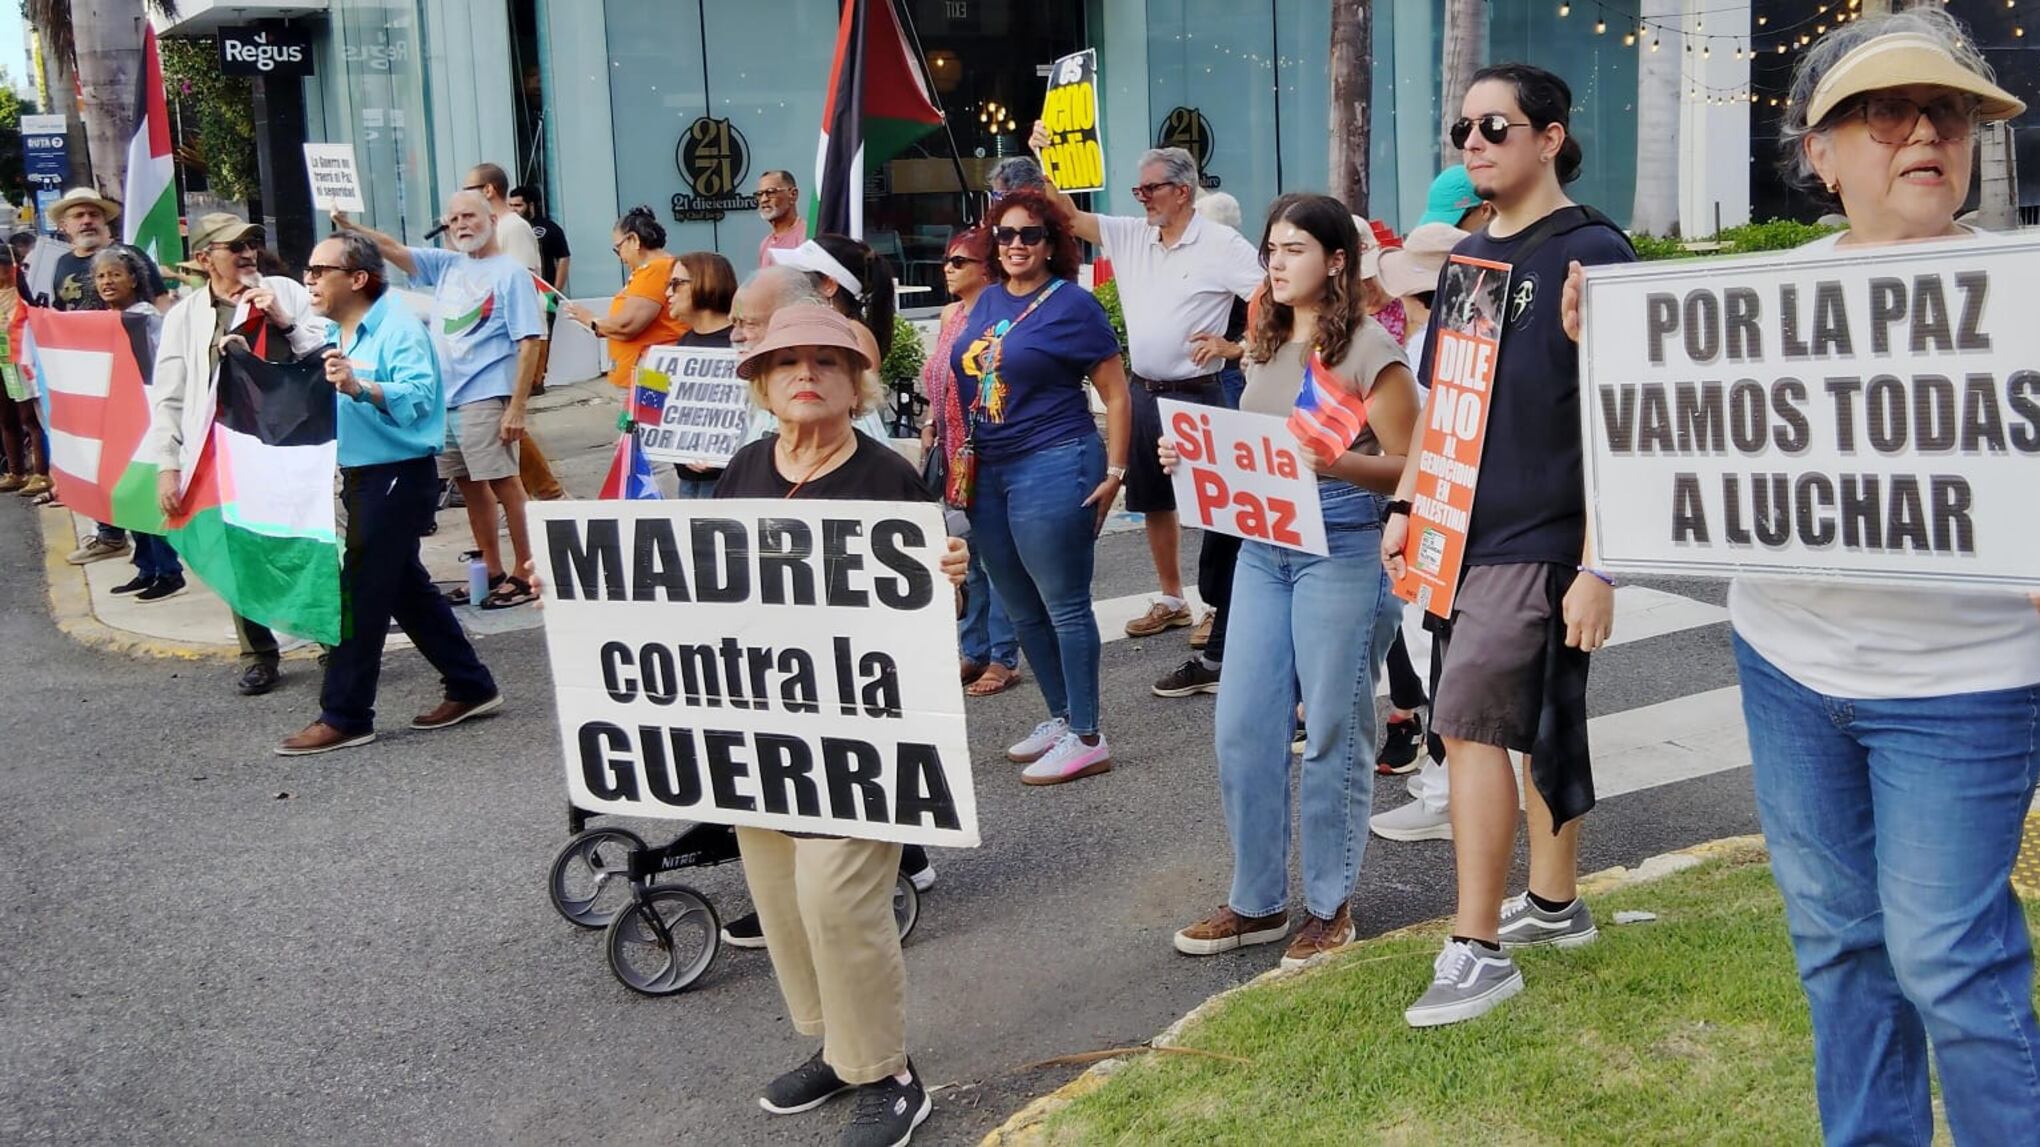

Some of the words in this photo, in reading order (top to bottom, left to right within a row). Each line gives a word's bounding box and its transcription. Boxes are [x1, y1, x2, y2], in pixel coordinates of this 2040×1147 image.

[225, 38, 303, 71] Regus
[27, 137, 51, 149] RUTA
[692, 119, 731, 155] 21
[673, 195, 689, 210] 21
[692, 195, 759, 210] diciembre
[1645, 286, 1764, 367] POR
[1778, 279, 1855, 359] LA
[1868, 270, 1993, 354] PAZ
[655, 356, 679, 377] LA
[683, 357, 738, 379] GUER
[1438, 334, 1492, 392] DILE
[663, 404, 747, 430] CHEMOS
[675, 381, 743, 406] MUERT
[1430, 384, 1482, 440] NO
[1599, 376, 1812, 457] VAMOS
[1823, 369, 2040, 457] TODAS
[676, 430, 700, 451] LA
[1172, 411, 1217, 465] Si
[1233, 440, 1257, 472] a
[1261, 436, 1300, 480] la
[1419, 450, 1477, 489] GENOCIDIO
[1192, 467, 1303, 547] Paz
[1411, 492, 1468, 534] PALESTINA
[1671, 471, 1711, 546] A
[1721, 471, 1977, 555] LUCHAR
[544, 517, 935, 611] MADRES
[600, 637, 820, 714] contra
[832, 636, 904, 719] la
[578, 720, 962, 831] GUERRA
